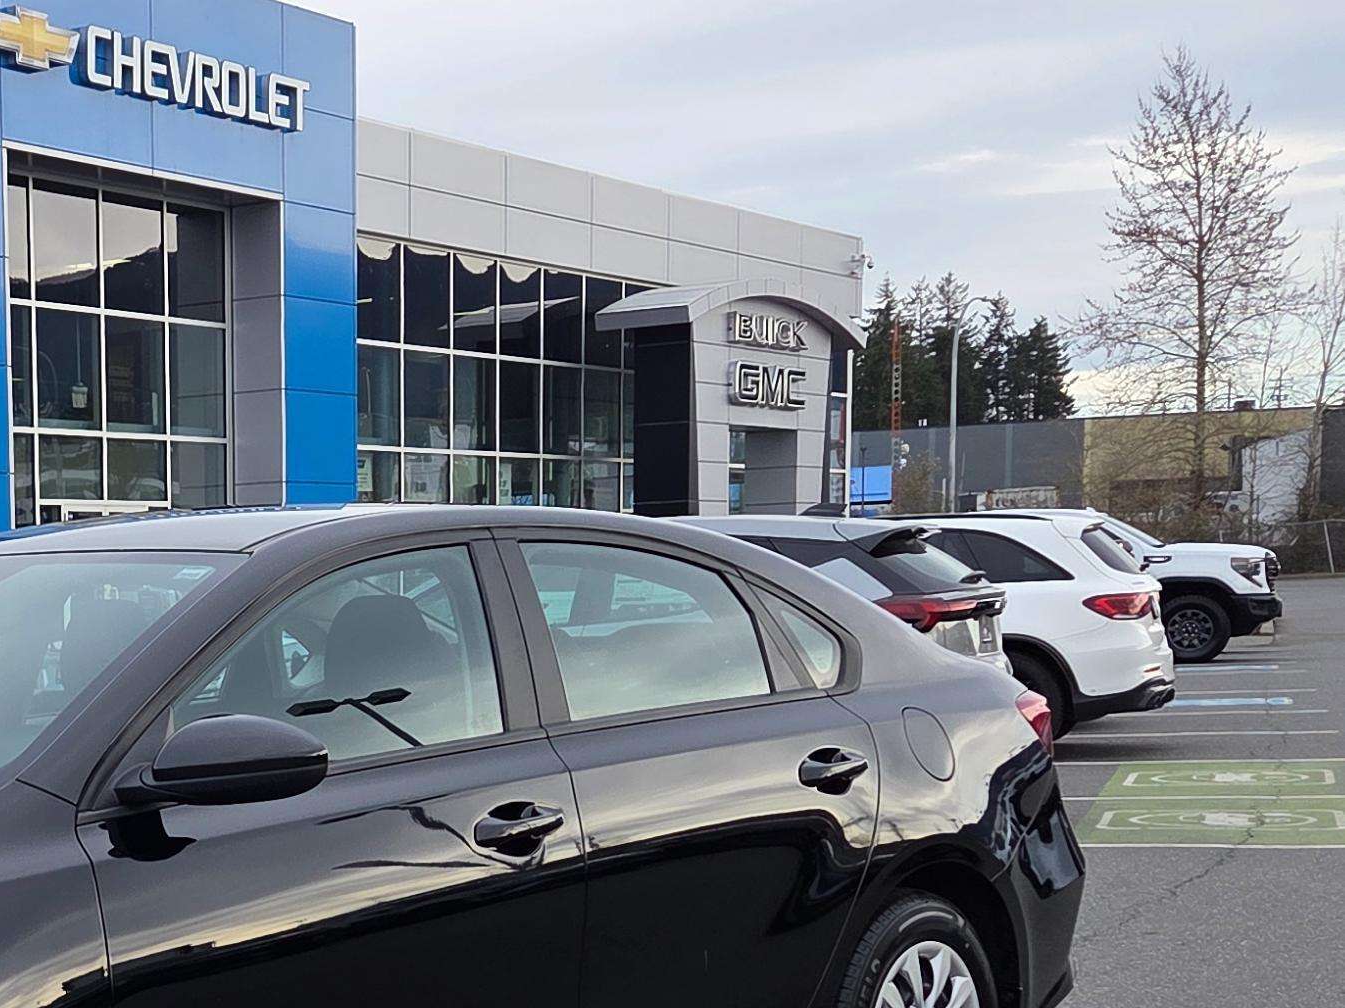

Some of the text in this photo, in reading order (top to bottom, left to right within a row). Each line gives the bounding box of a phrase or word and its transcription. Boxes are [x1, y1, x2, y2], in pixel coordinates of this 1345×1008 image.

[86, 24, 311, 132] CHEVROLET
[733, 312, 808, 349] BUICK
[733, 360, 807, 408] GMC
